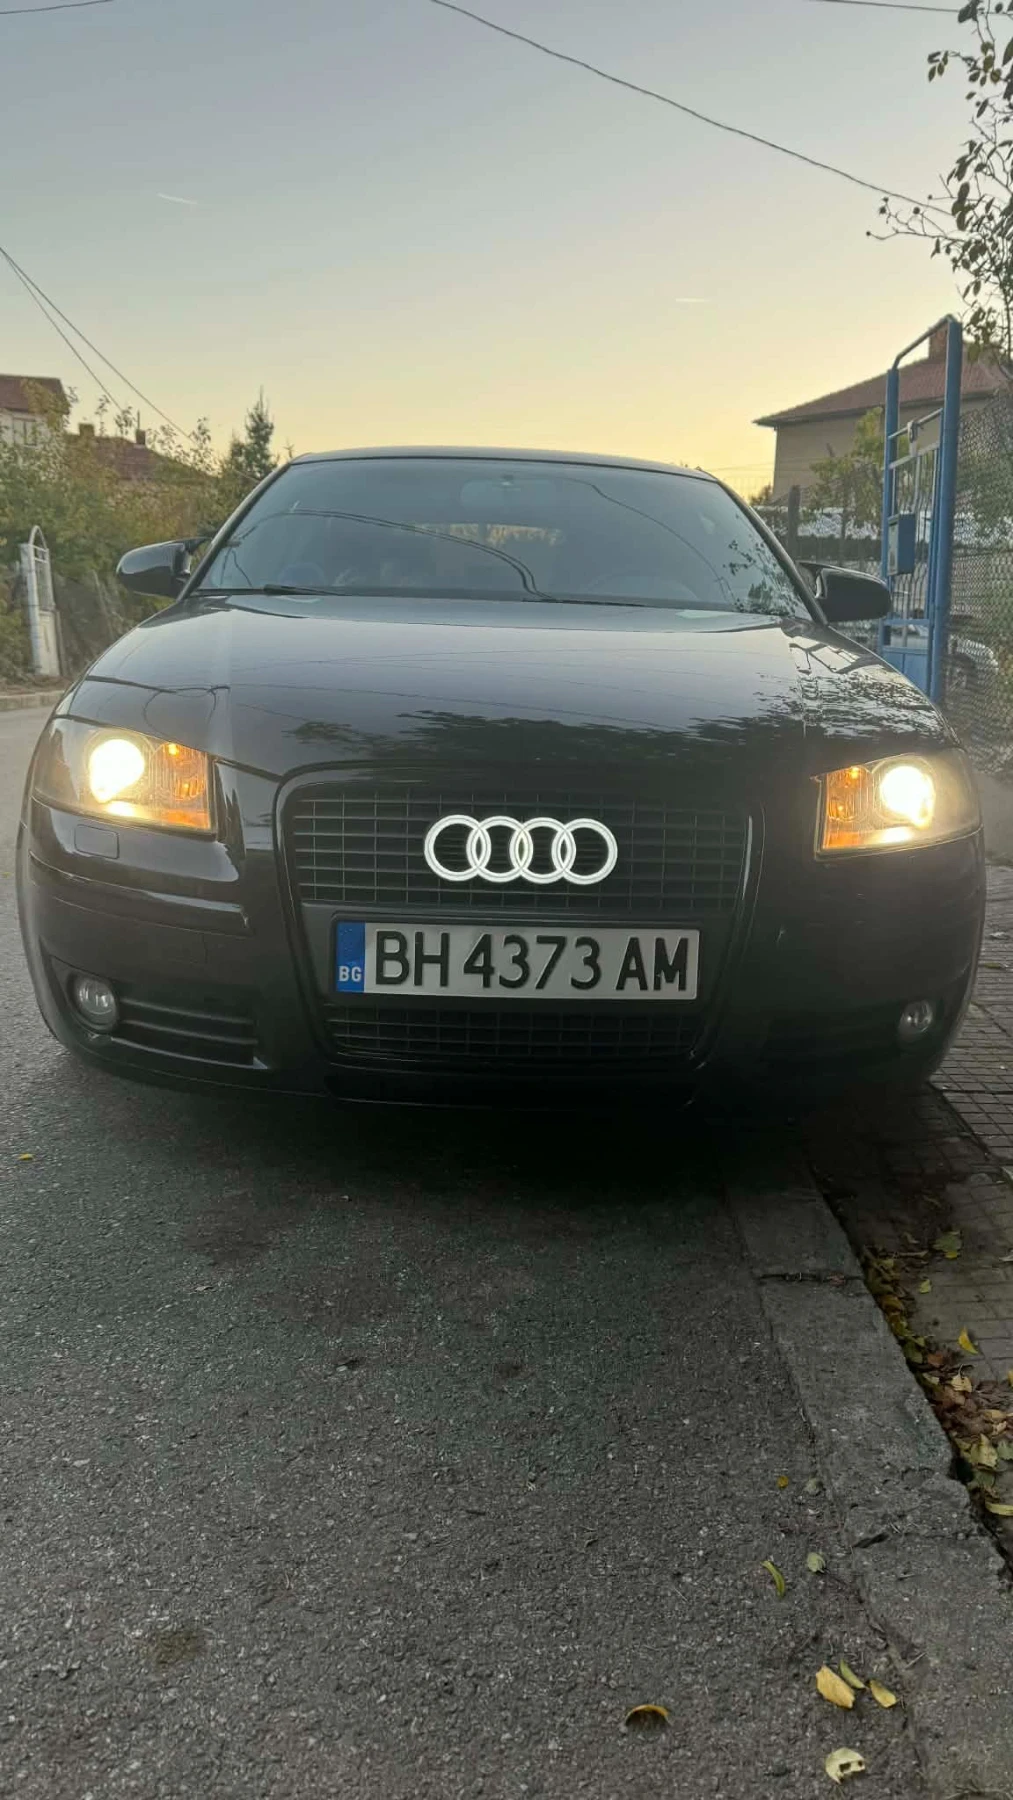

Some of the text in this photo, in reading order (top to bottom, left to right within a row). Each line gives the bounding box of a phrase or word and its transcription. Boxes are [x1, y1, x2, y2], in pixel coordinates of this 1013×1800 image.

[338, 966, 362, 982] BG
[375, 930, 689, 992] BH 4373 AM
